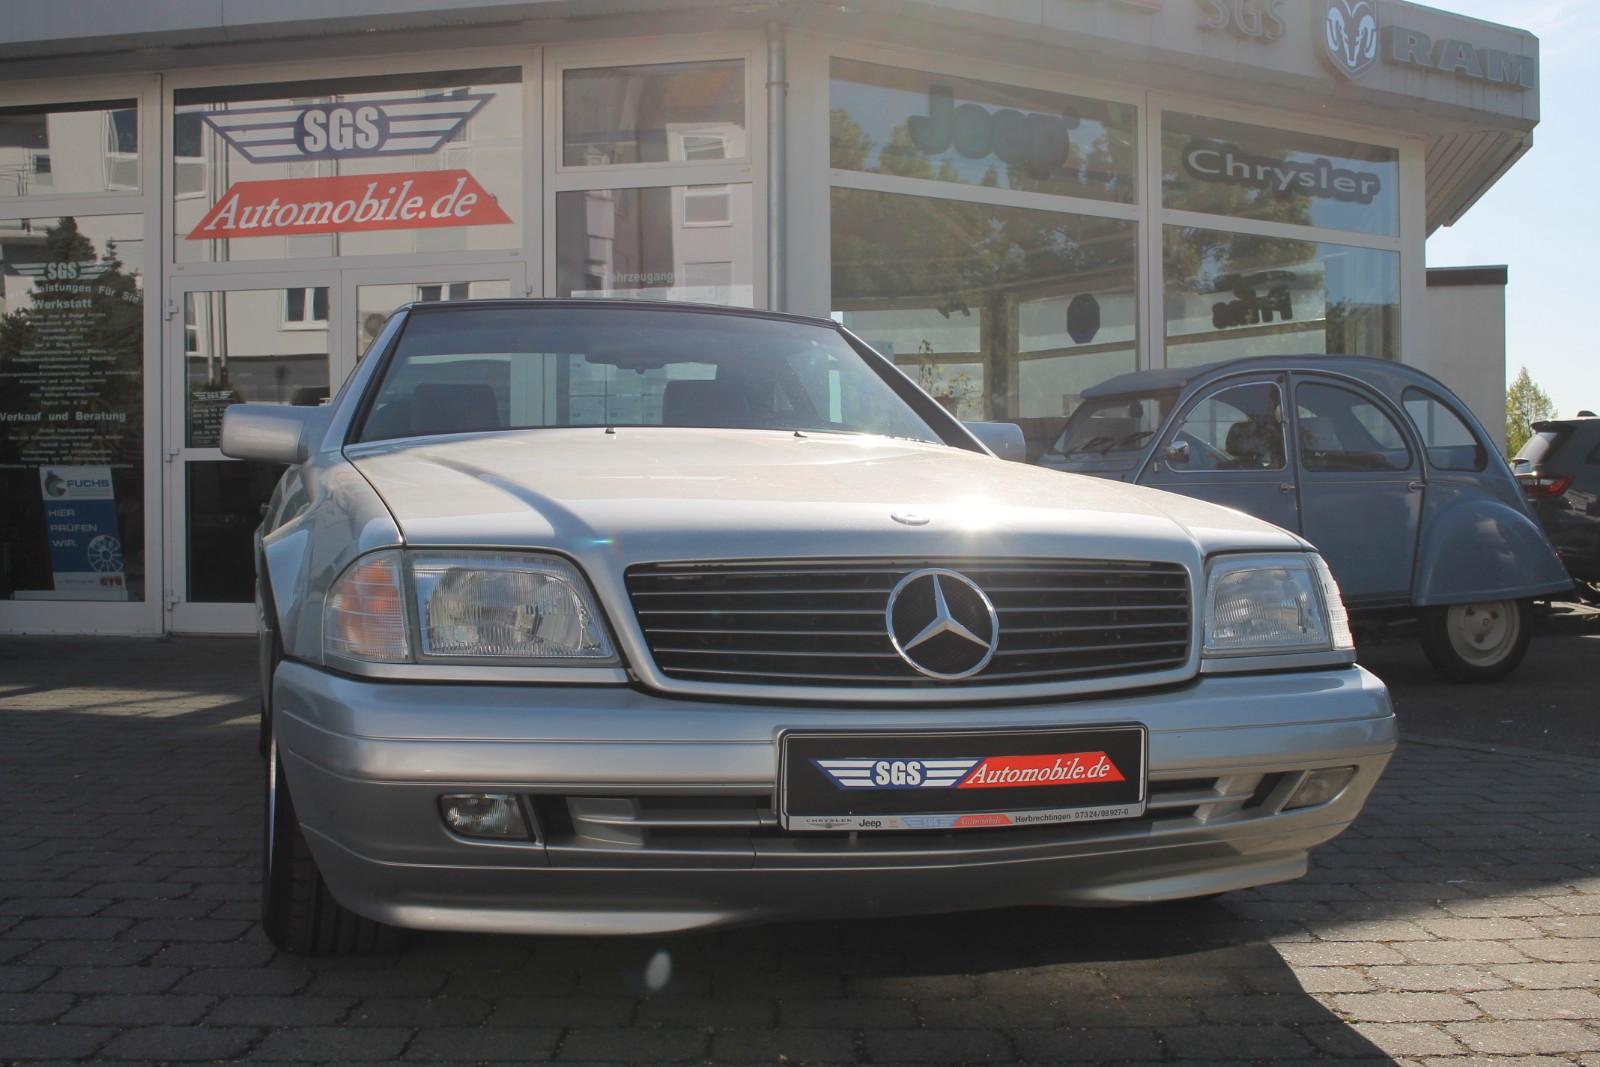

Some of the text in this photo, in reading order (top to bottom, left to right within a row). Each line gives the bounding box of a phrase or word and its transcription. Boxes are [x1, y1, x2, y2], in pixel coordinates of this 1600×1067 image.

[1387, 26, 1534, 88] RAM
[303, 105, 379, 153] SGS
[1187, 148, 1378, 196] Chrysler
[203, 176, 478, 231] Automobile.de
[47, 262, 77, 280] SGS
[32, 298, 93, 310] Werkstatt
[0, 410, 126, 422] Verkauf und Beratung
[66, 479, 111, 488] FUCHS
[48, 508, 76, 517] HIER
[875, 755, 1111, 786] SGS Automobile.de
[858, 819, 882, 829] Jeep
